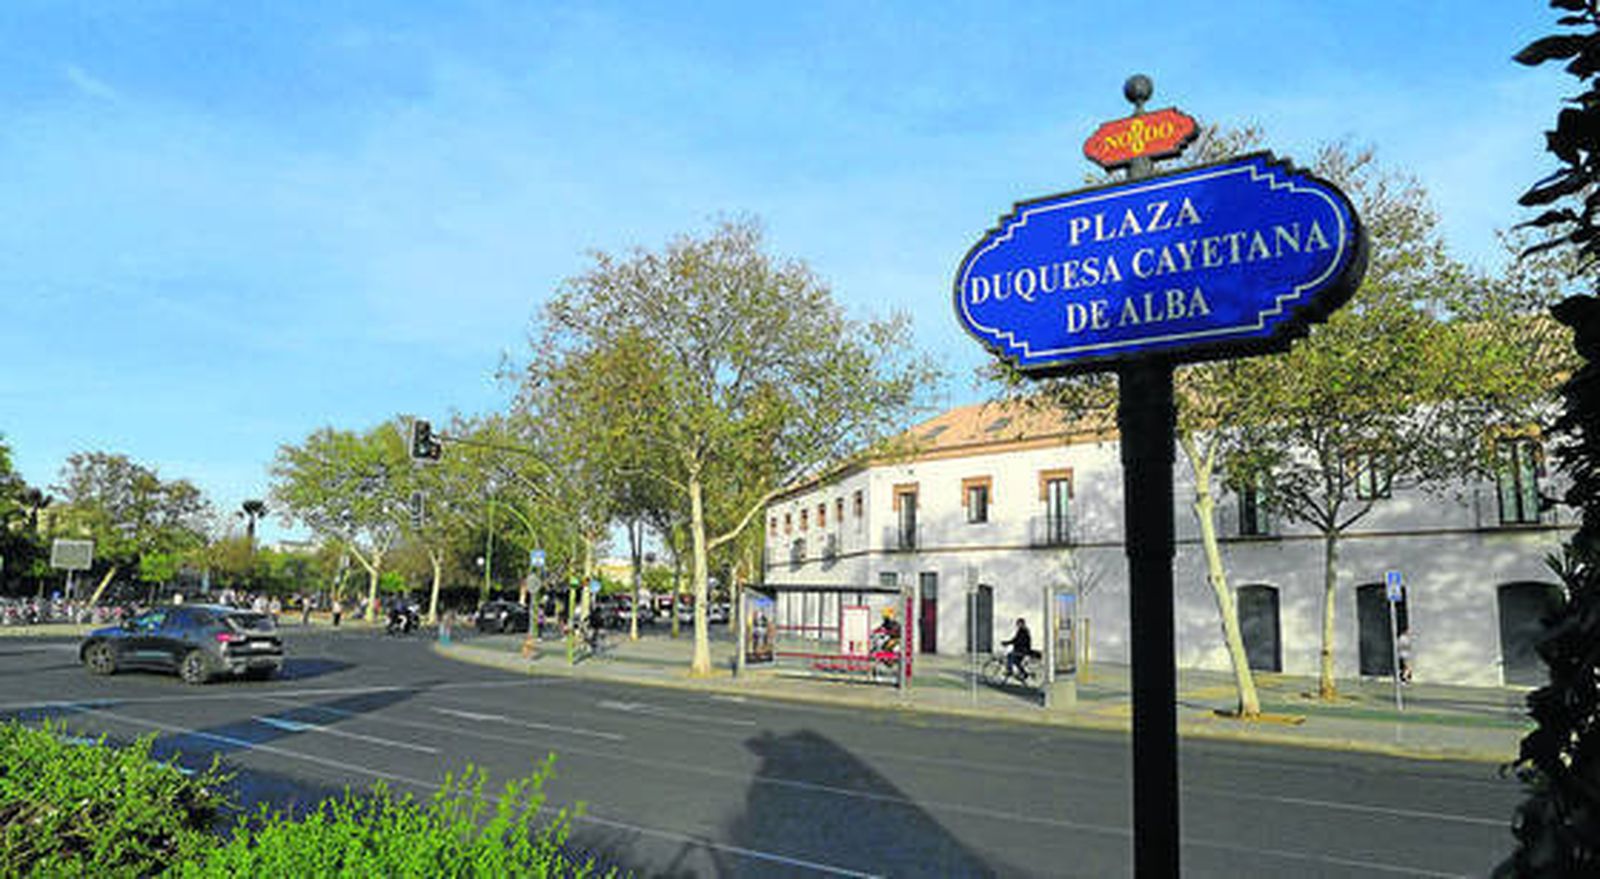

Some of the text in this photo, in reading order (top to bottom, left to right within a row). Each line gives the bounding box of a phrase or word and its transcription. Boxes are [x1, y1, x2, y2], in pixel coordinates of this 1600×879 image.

[1069, 197, 1201, 245] PLAZA
[970, 222, 1330, 304] DUQUESA CAYETANA
[1067, 288, 1210, 334] DE ALBA
